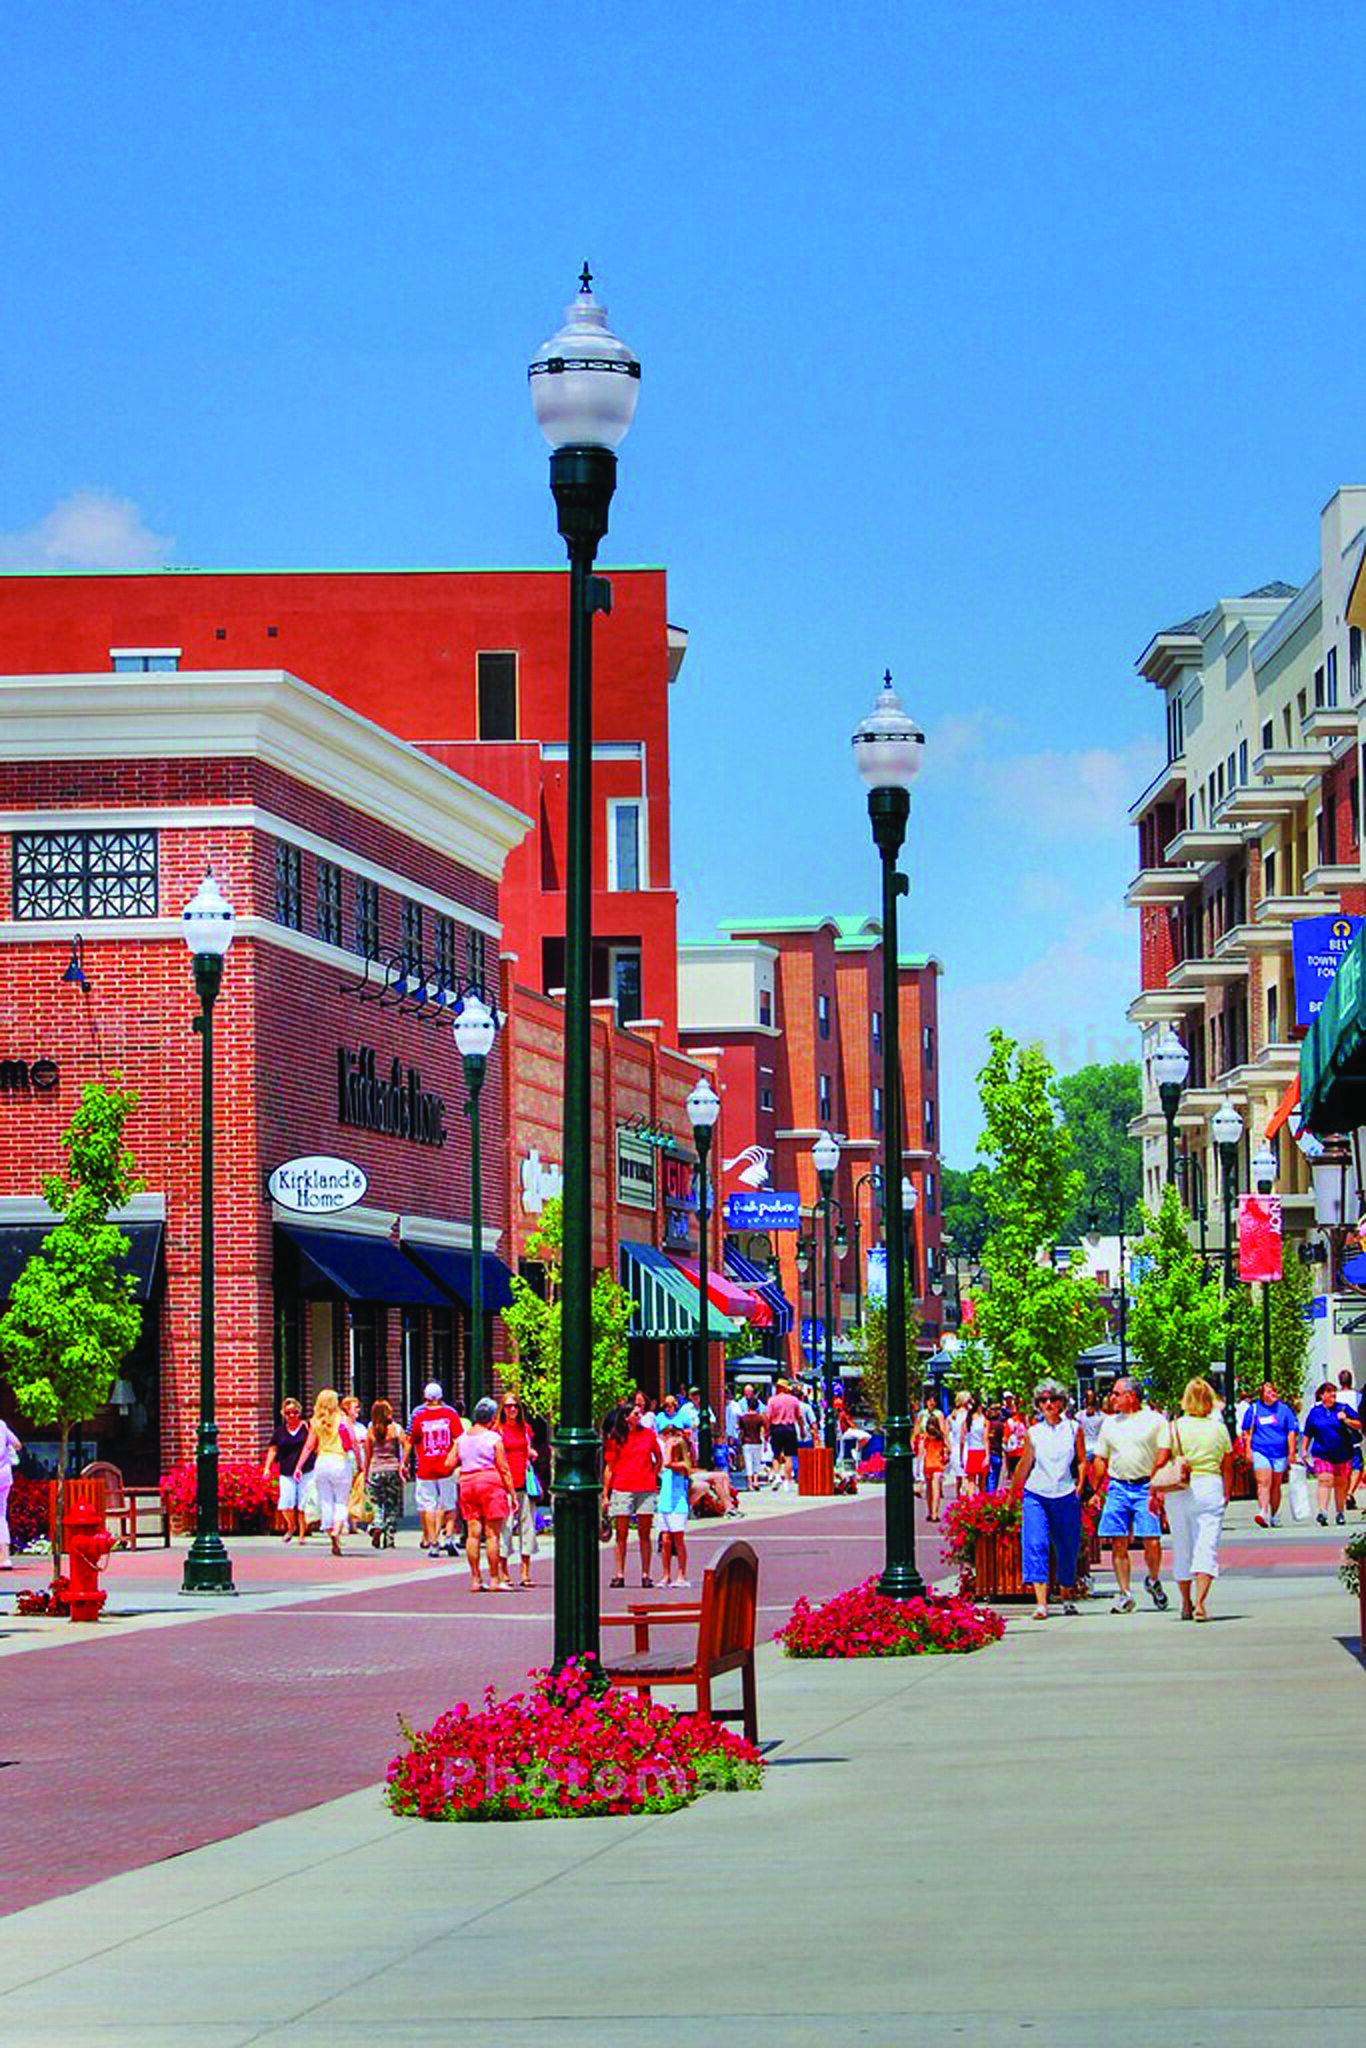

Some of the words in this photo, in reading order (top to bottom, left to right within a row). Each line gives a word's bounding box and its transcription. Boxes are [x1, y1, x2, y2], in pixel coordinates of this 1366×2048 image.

[1307, 956, 1337, 966] TOWN
[279, 1169, 362, 1189] Kirkland's
[297, 1189, 344, 1207] Home
